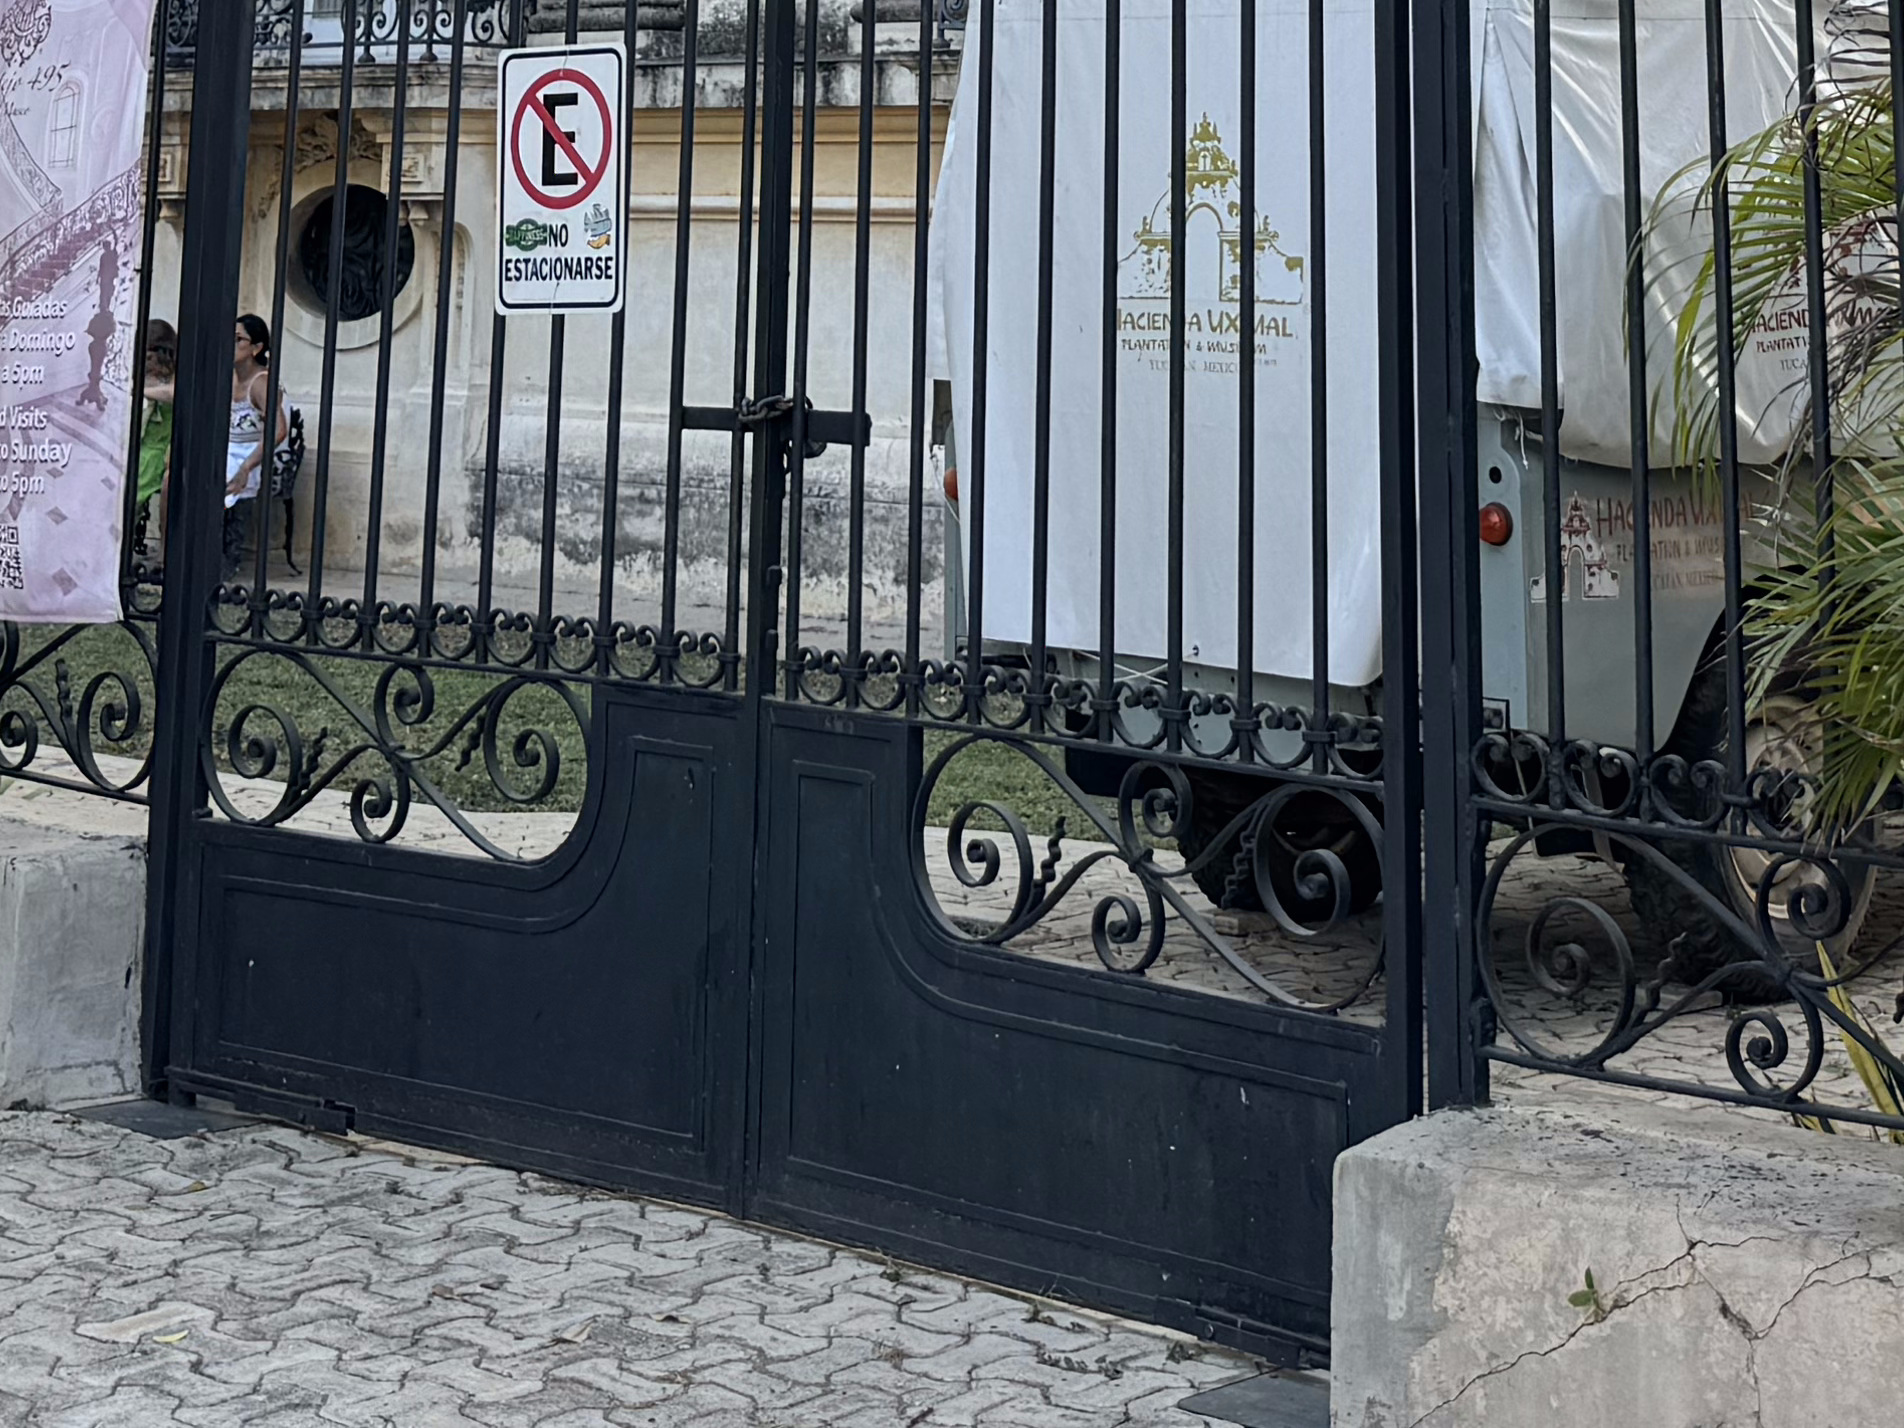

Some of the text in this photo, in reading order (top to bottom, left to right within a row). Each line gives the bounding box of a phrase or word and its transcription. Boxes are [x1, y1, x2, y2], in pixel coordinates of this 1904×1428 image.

[27, 61, 72, 93] 495
[542, 92, 579, 187] E
[548, 223, 569, 248] NO
[504, 255, 614, 282] ESTACIONARSE
[1117, 308, 1202, 332] ACIENA
[1752, 308, 1810, 333] ACIEND
[9, 328, 76, 357] Domingo
[1121, 338, 1191, 352] PLANTATN
[1207, 340, 1267, 355] MUSM
[1756, 335, 1807, 354] PLANTATI
[11, 362, 45, 391] 5pm
[9, 405, 49, 431] Visits
[11, 437, 73, 469] Sunday
[10, 470, 45, 499] 5pm
[1596, 496, 1687, 537] HACNDA
